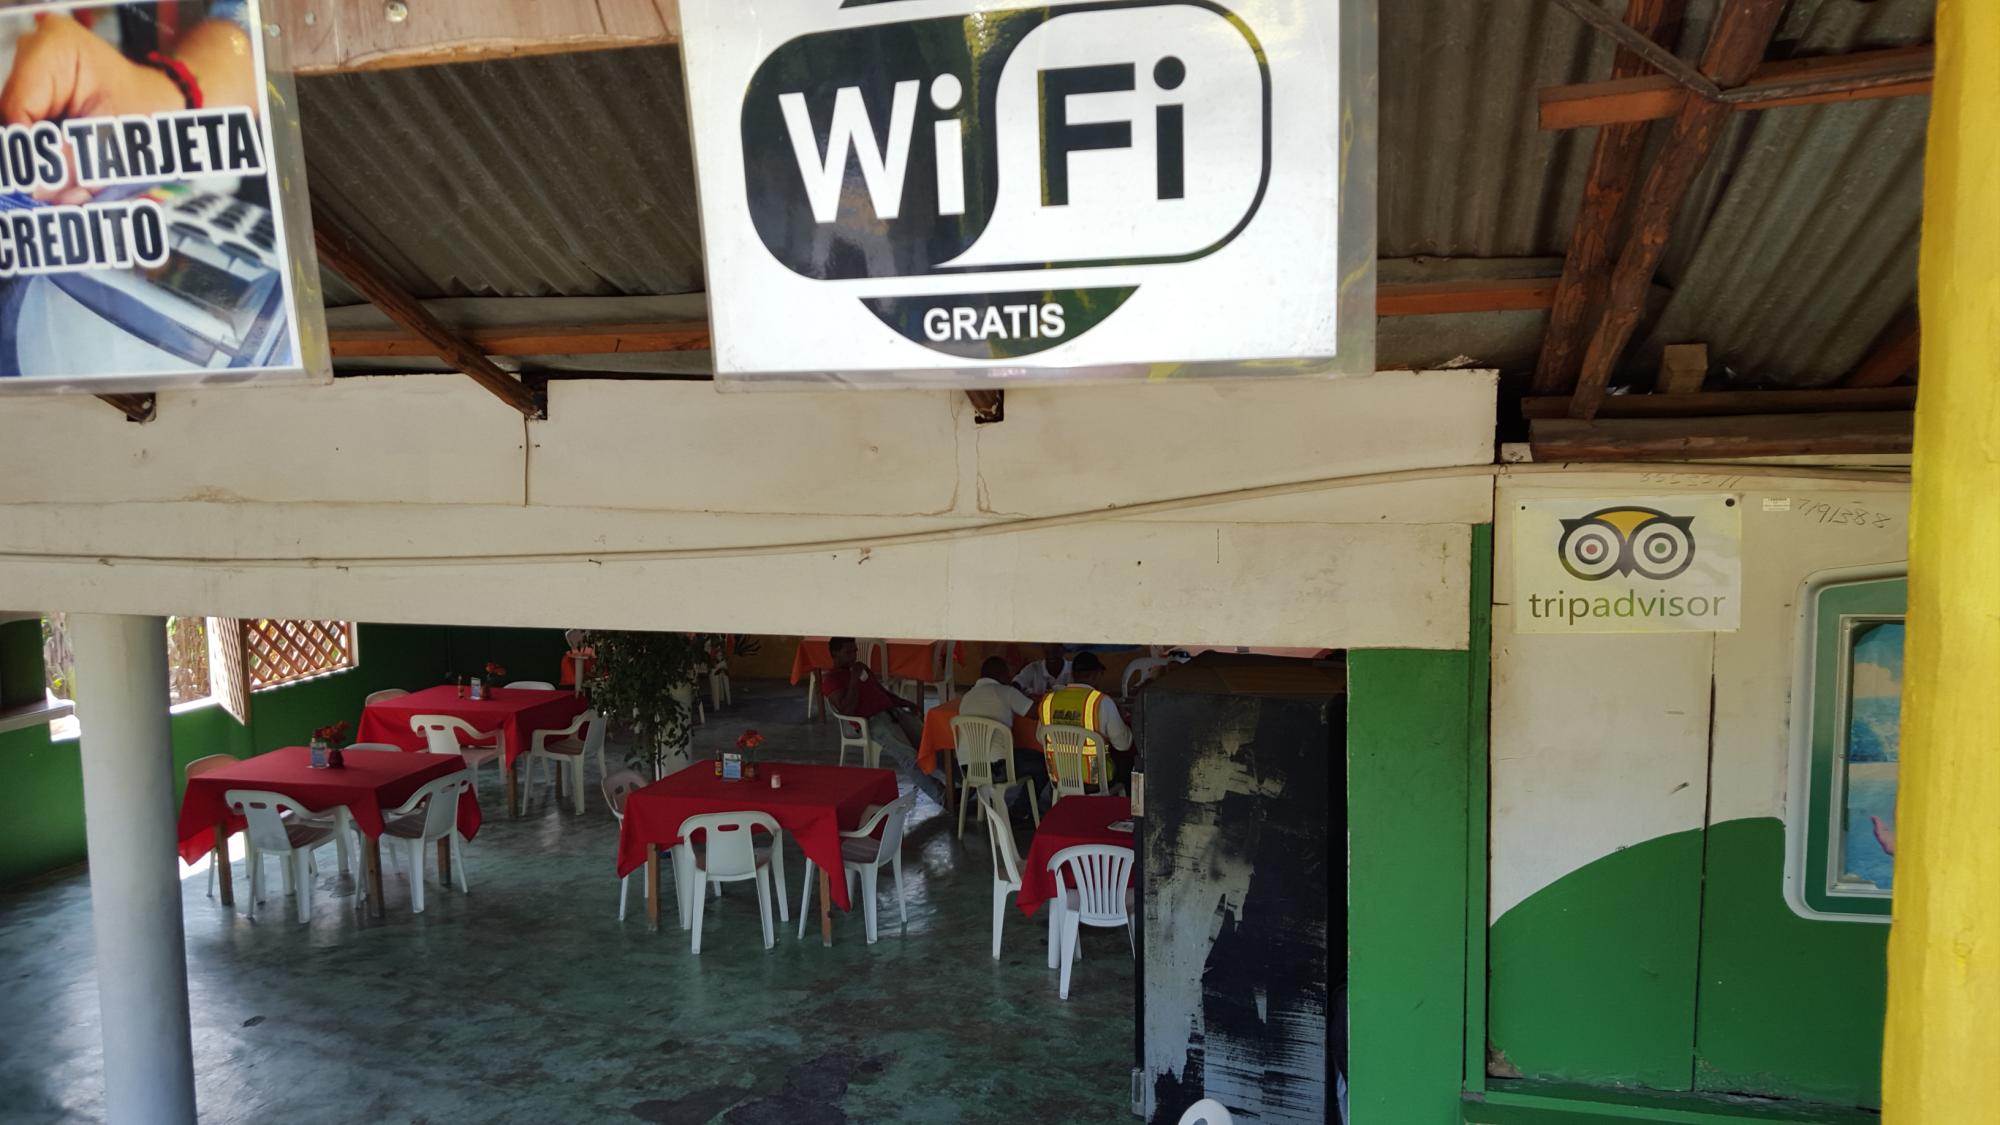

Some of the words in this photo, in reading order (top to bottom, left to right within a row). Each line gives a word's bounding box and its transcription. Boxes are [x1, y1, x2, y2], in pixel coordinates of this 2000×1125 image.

[0, 126, 65, 188] OS
[67, 112, 261, 182] TARJETA
[778, 73, 965, 224] Wi
[1037, 55, 1187, 208] Fi
[923, 302, 1066, 343] GRATIS
[1528, 588, 1727, 626] tripadvisor
